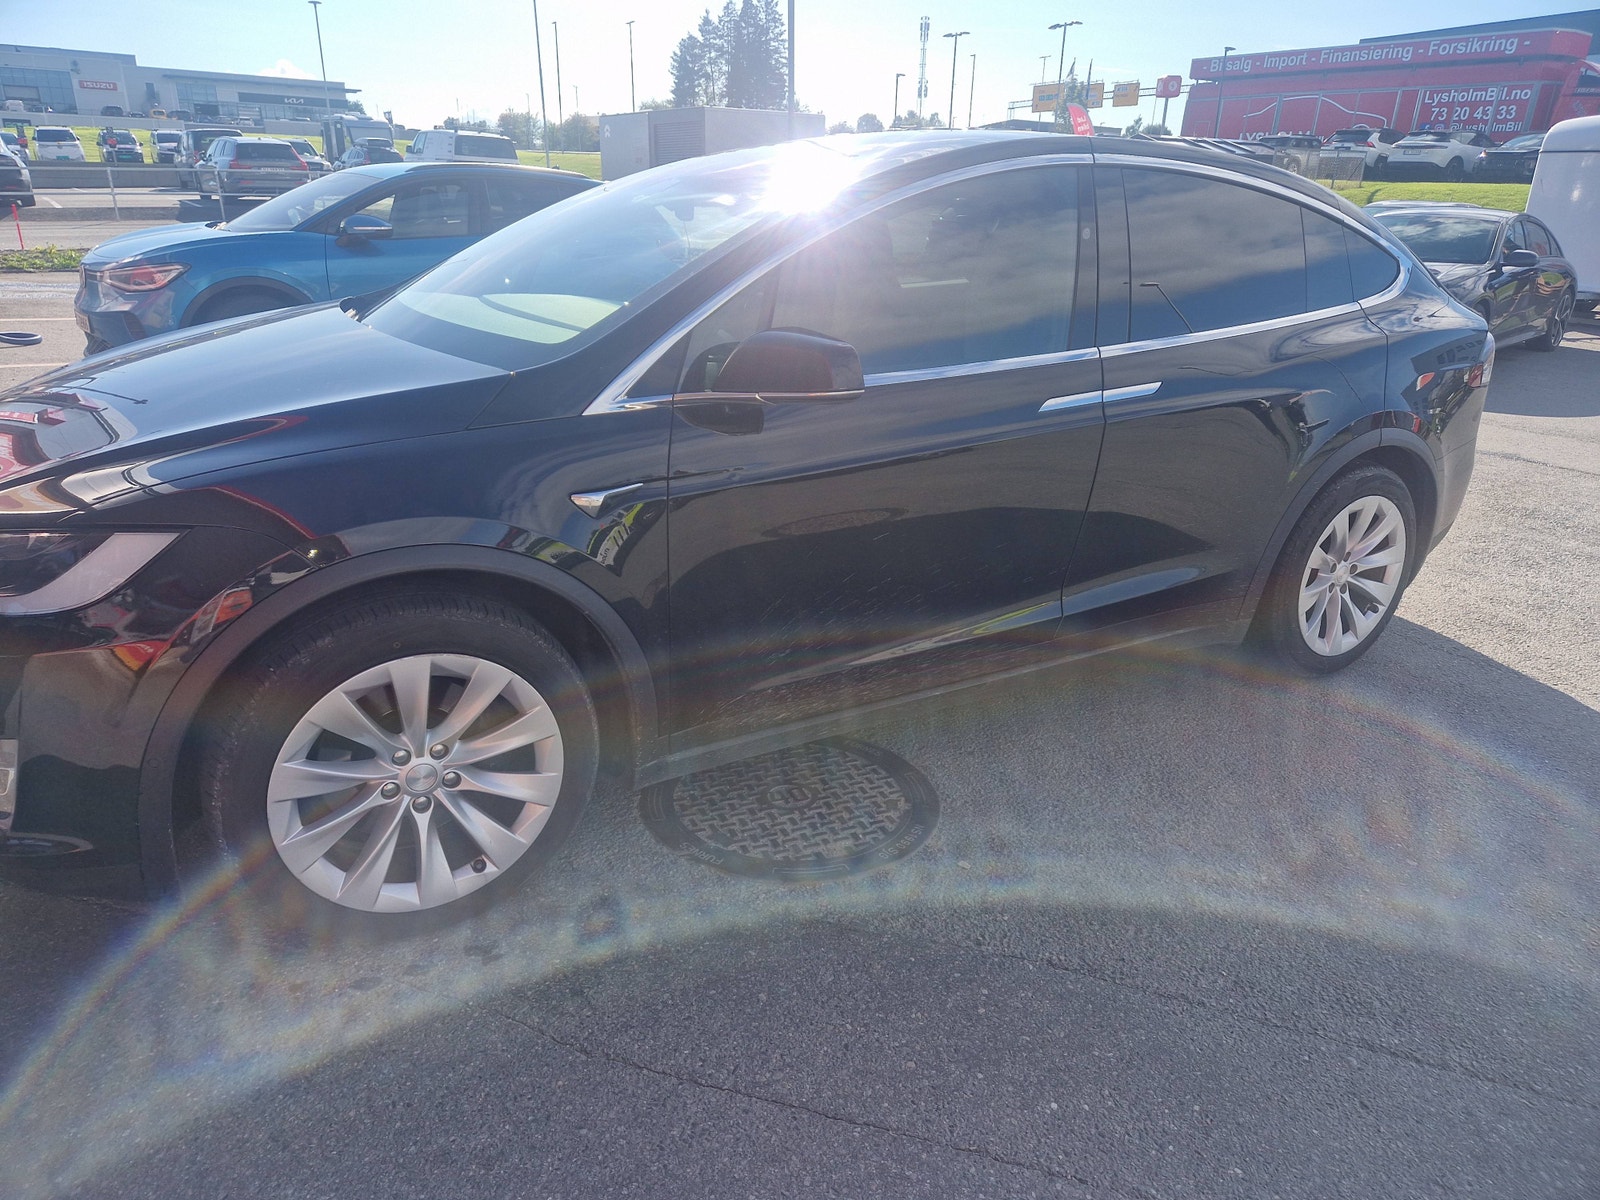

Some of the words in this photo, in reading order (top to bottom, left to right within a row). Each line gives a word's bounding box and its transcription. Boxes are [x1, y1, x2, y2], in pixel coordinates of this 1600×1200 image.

[1210, 57, 1252, 73] Bisalg
[1263, 52, 1308, 70] Import
[1319, 44, 1413, 64] Finansiering
[1428, 36, 1519, 56] Forsikring
[82, 81, 113, 89] ISUZU
[1425, 87, 1531, 106] LysholmBil.no
[1430, 107, 1448, 121] 73
[1452, 106, 1470, 120] 20
[1473, 106, 1493, 120] 43
[1496, 105, 1517, 119] 33
[680, 841, 724, 865] FURNES
